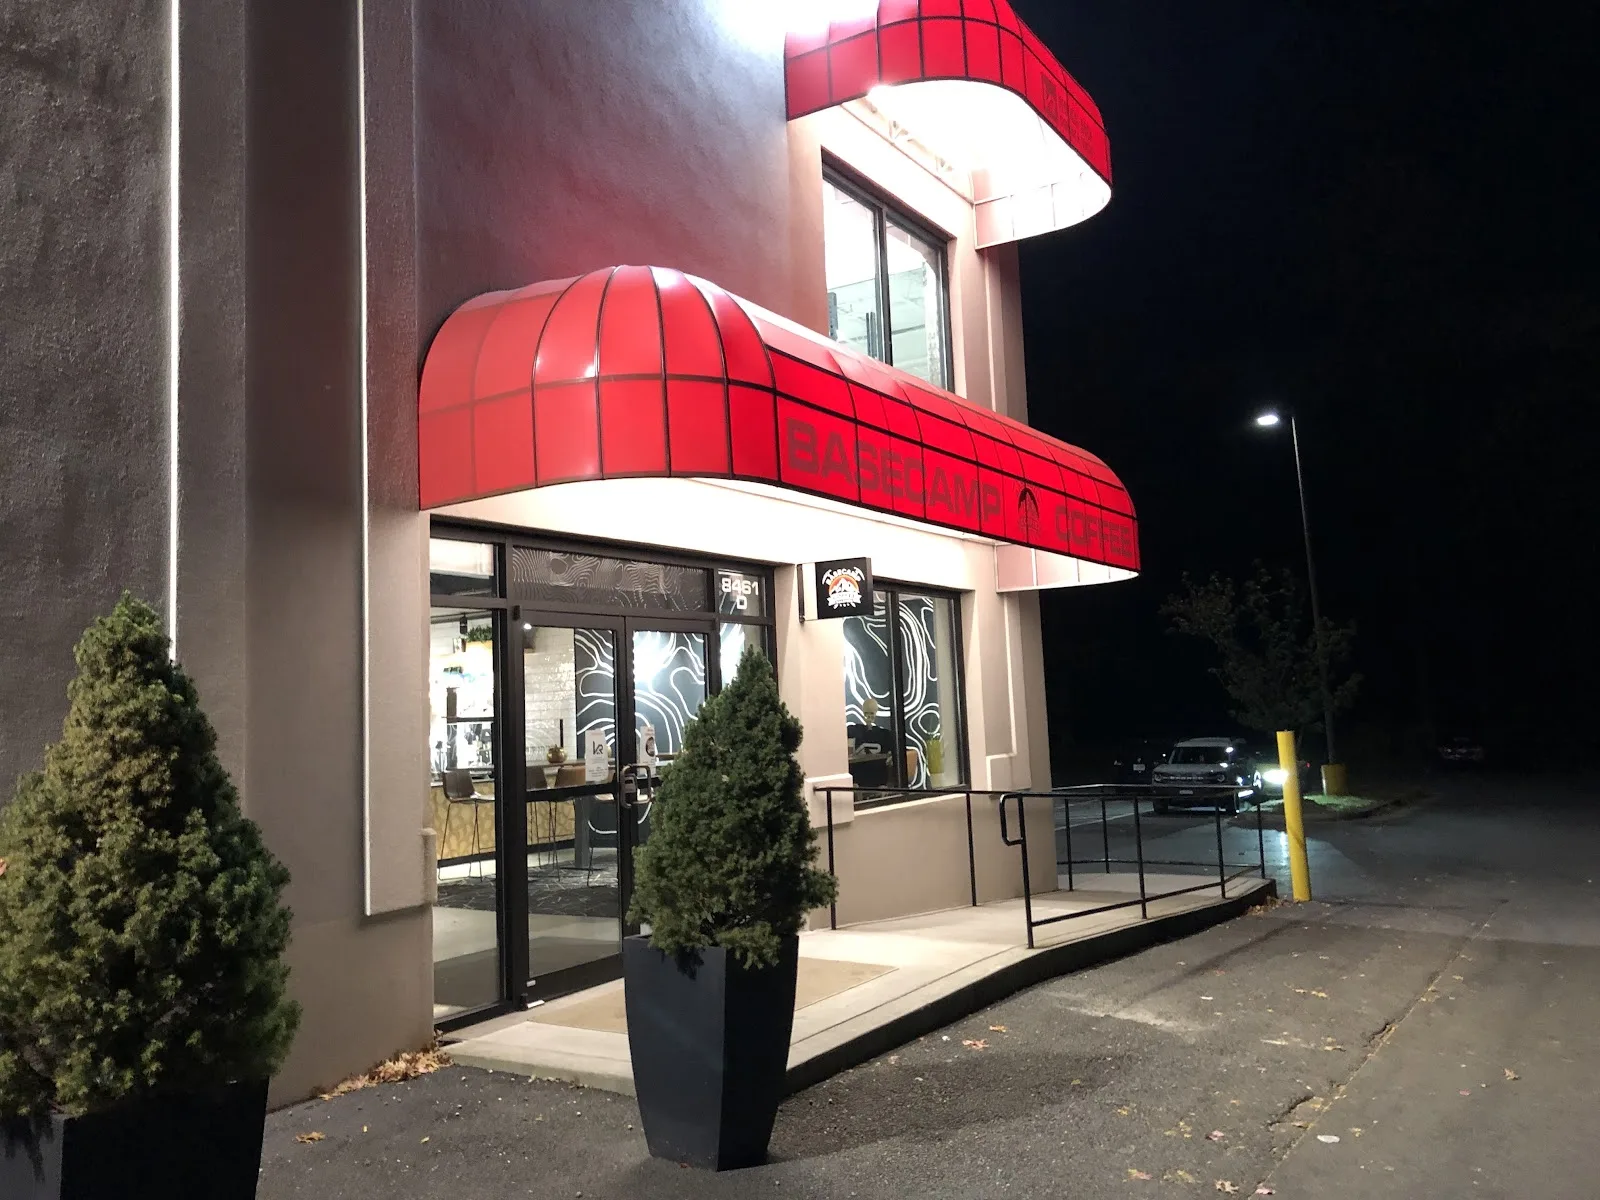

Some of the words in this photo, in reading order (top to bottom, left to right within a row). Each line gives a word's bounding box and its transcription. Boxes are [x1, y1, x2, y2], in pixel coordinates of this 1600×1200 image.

[786, 417, 1001, 523] BASECAMP
[1055, 504, 1132, 558] COFFEE
[722, 577, 759, 596] 8461
